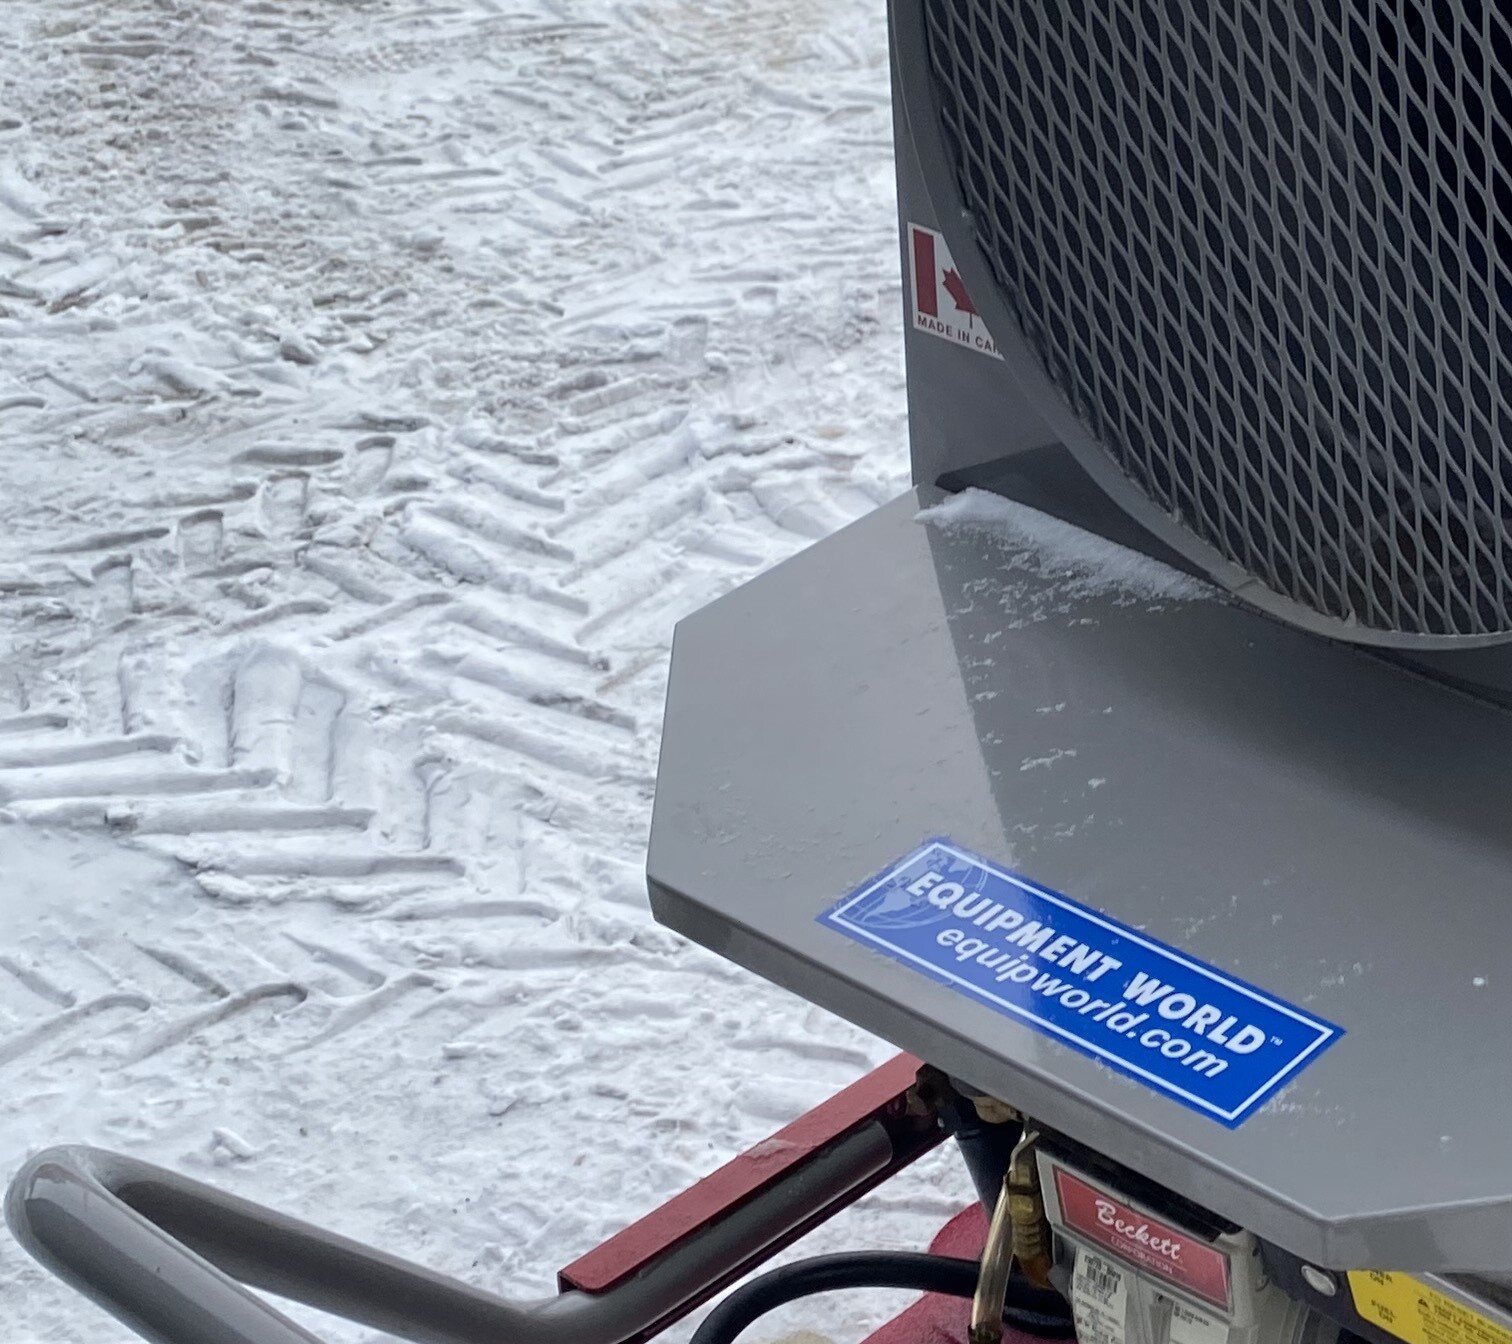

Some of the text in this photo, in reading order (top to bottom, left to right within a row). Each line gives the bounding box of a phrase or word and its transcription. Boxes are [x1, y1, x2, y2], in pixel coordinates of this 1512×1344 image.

[917, 314, 953, 338] MADE
[957, 329, 970, 343] IN
[907, 870, 1268, 1056] EQUIPMENT WORLD
[936, 924, 1230, 1081] equipworld.com
[1094, 1199, 1182, 1261] Beckett
